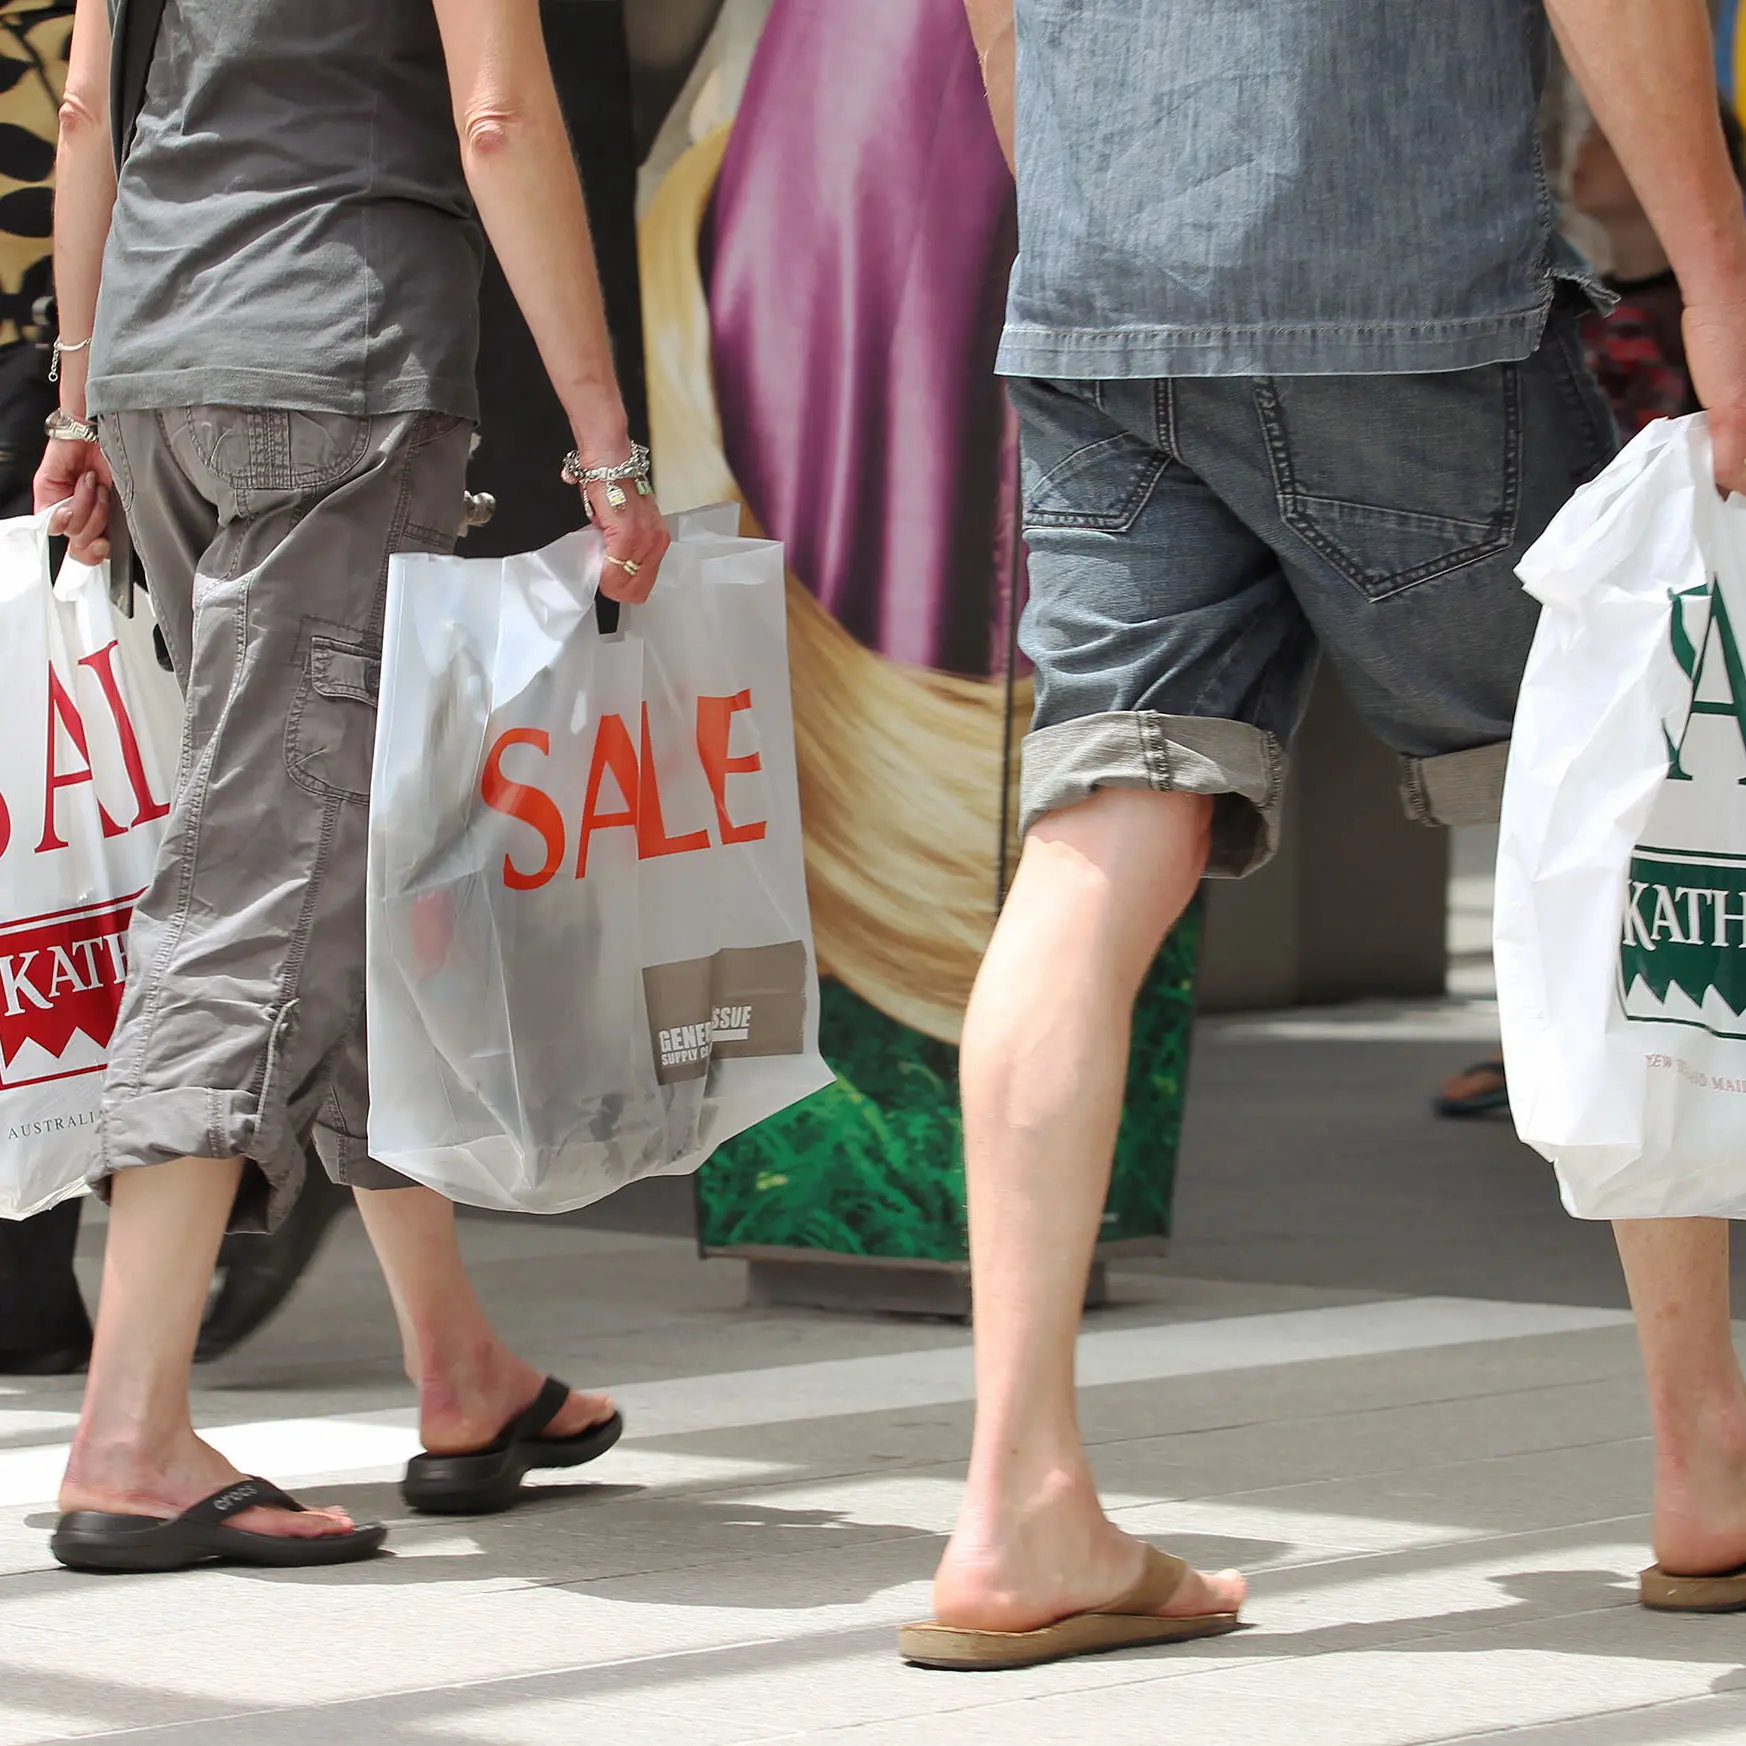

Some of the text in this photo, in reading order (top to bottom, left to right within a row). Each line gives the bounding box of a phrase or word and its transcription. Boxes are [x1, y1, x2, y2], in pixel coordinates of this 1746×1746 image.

[481, 688, 767, 891] SALE
[661, 1047, 698, 1066] SUPPLY
[213, 1484, 258, 1511] crocs
